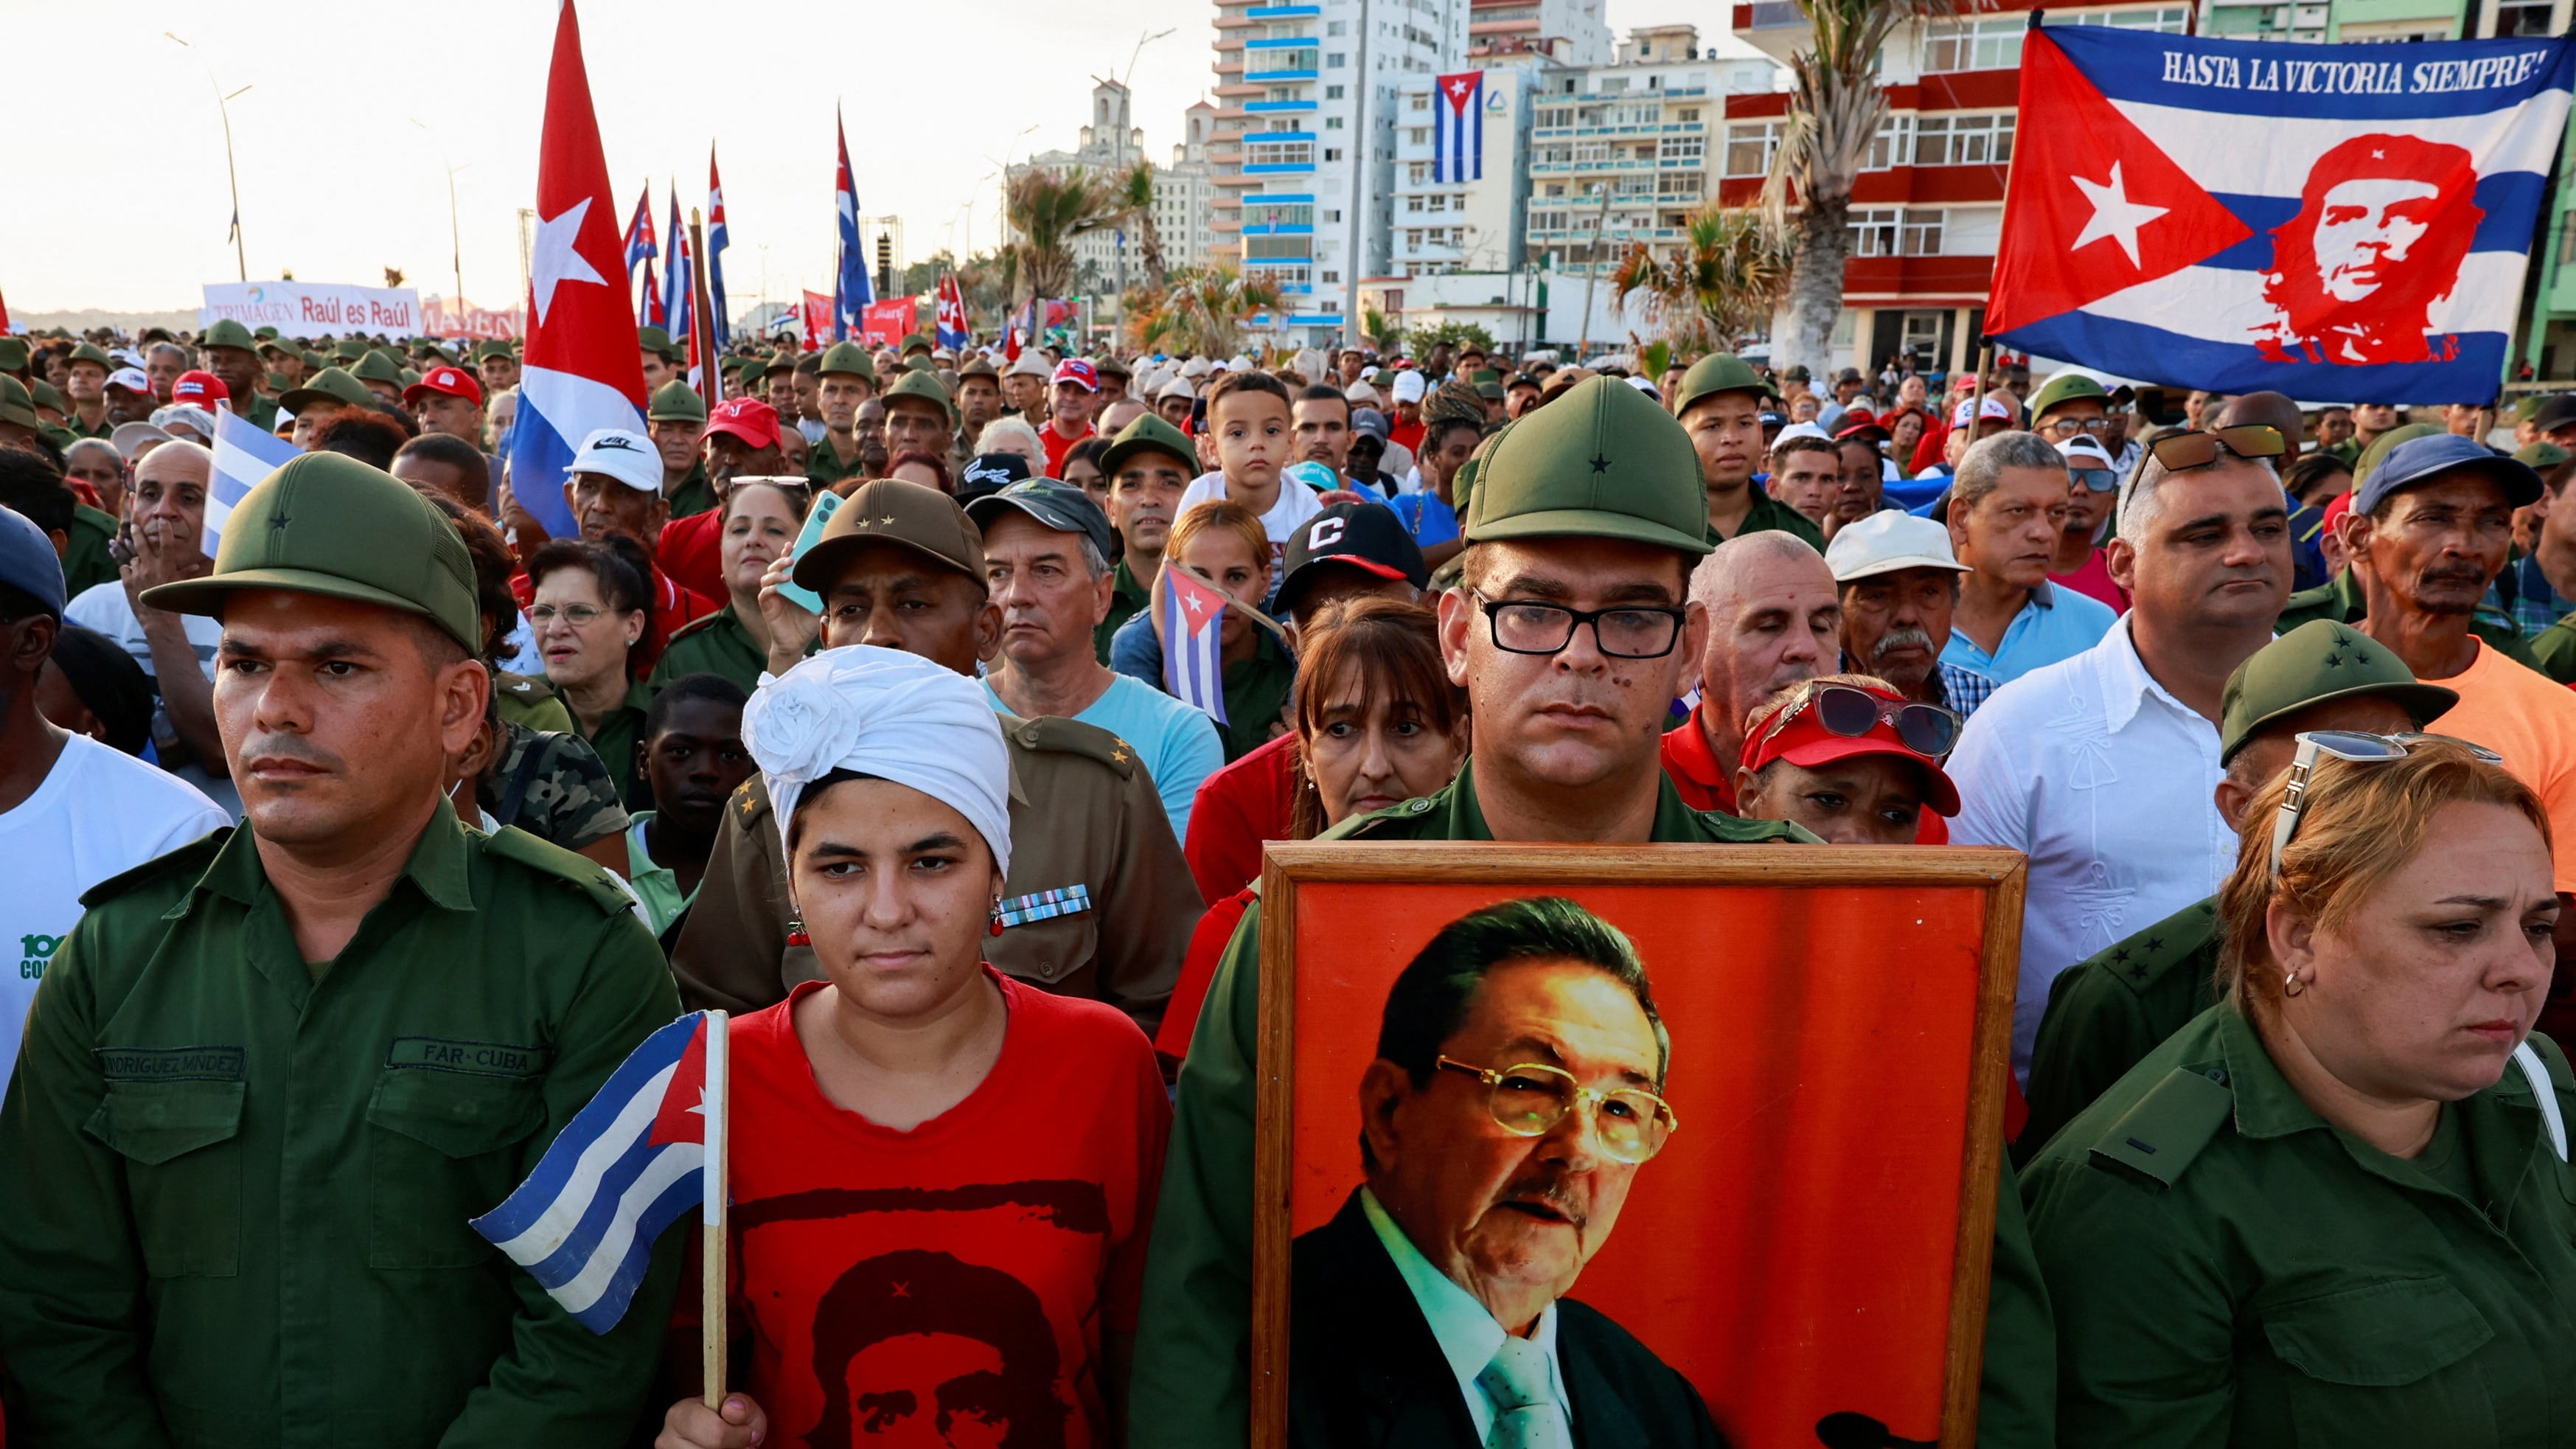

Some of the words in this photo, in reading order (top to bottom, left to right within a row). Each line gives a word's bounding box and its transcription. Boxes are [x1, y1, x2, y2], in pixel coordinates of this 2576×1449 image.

[2162, 51, 2241, 89] HASTA
[2247, 59, 2280, 91] LA
[2284, 60, 2403, 94] VICTORIA
[2409, 49, 2547, 94] SIEMPRE!
[212, 302, 295, 322] TRIMAGEN
[301, 296, 341, 324] Raúl
[347, 305, 366, 325] es
[371, 300, 411, 328] Raúl
[1308, 516, 1346, 552] C
